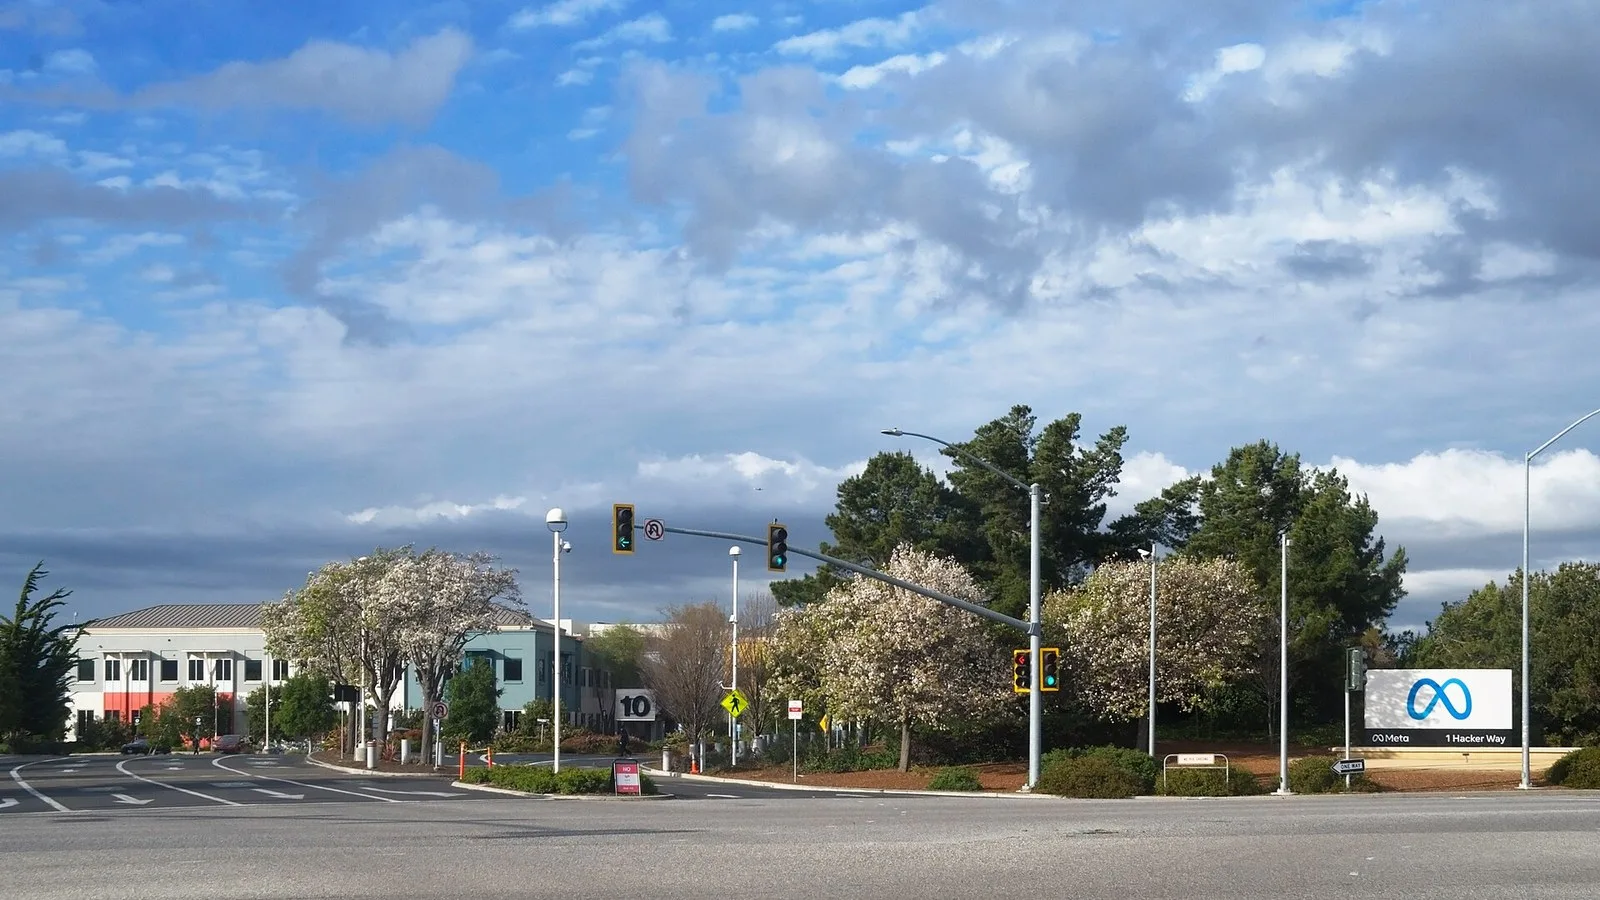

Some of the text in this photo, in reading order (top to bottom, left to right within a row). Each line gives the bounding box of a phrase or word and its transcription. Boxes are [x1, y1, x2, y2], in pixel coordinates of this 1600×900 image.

[620, 696, 651, 717] 10
[1385, 734, 1410, 743] Meta
[1445, 734, 1506, 745] 1 Hacker Way
